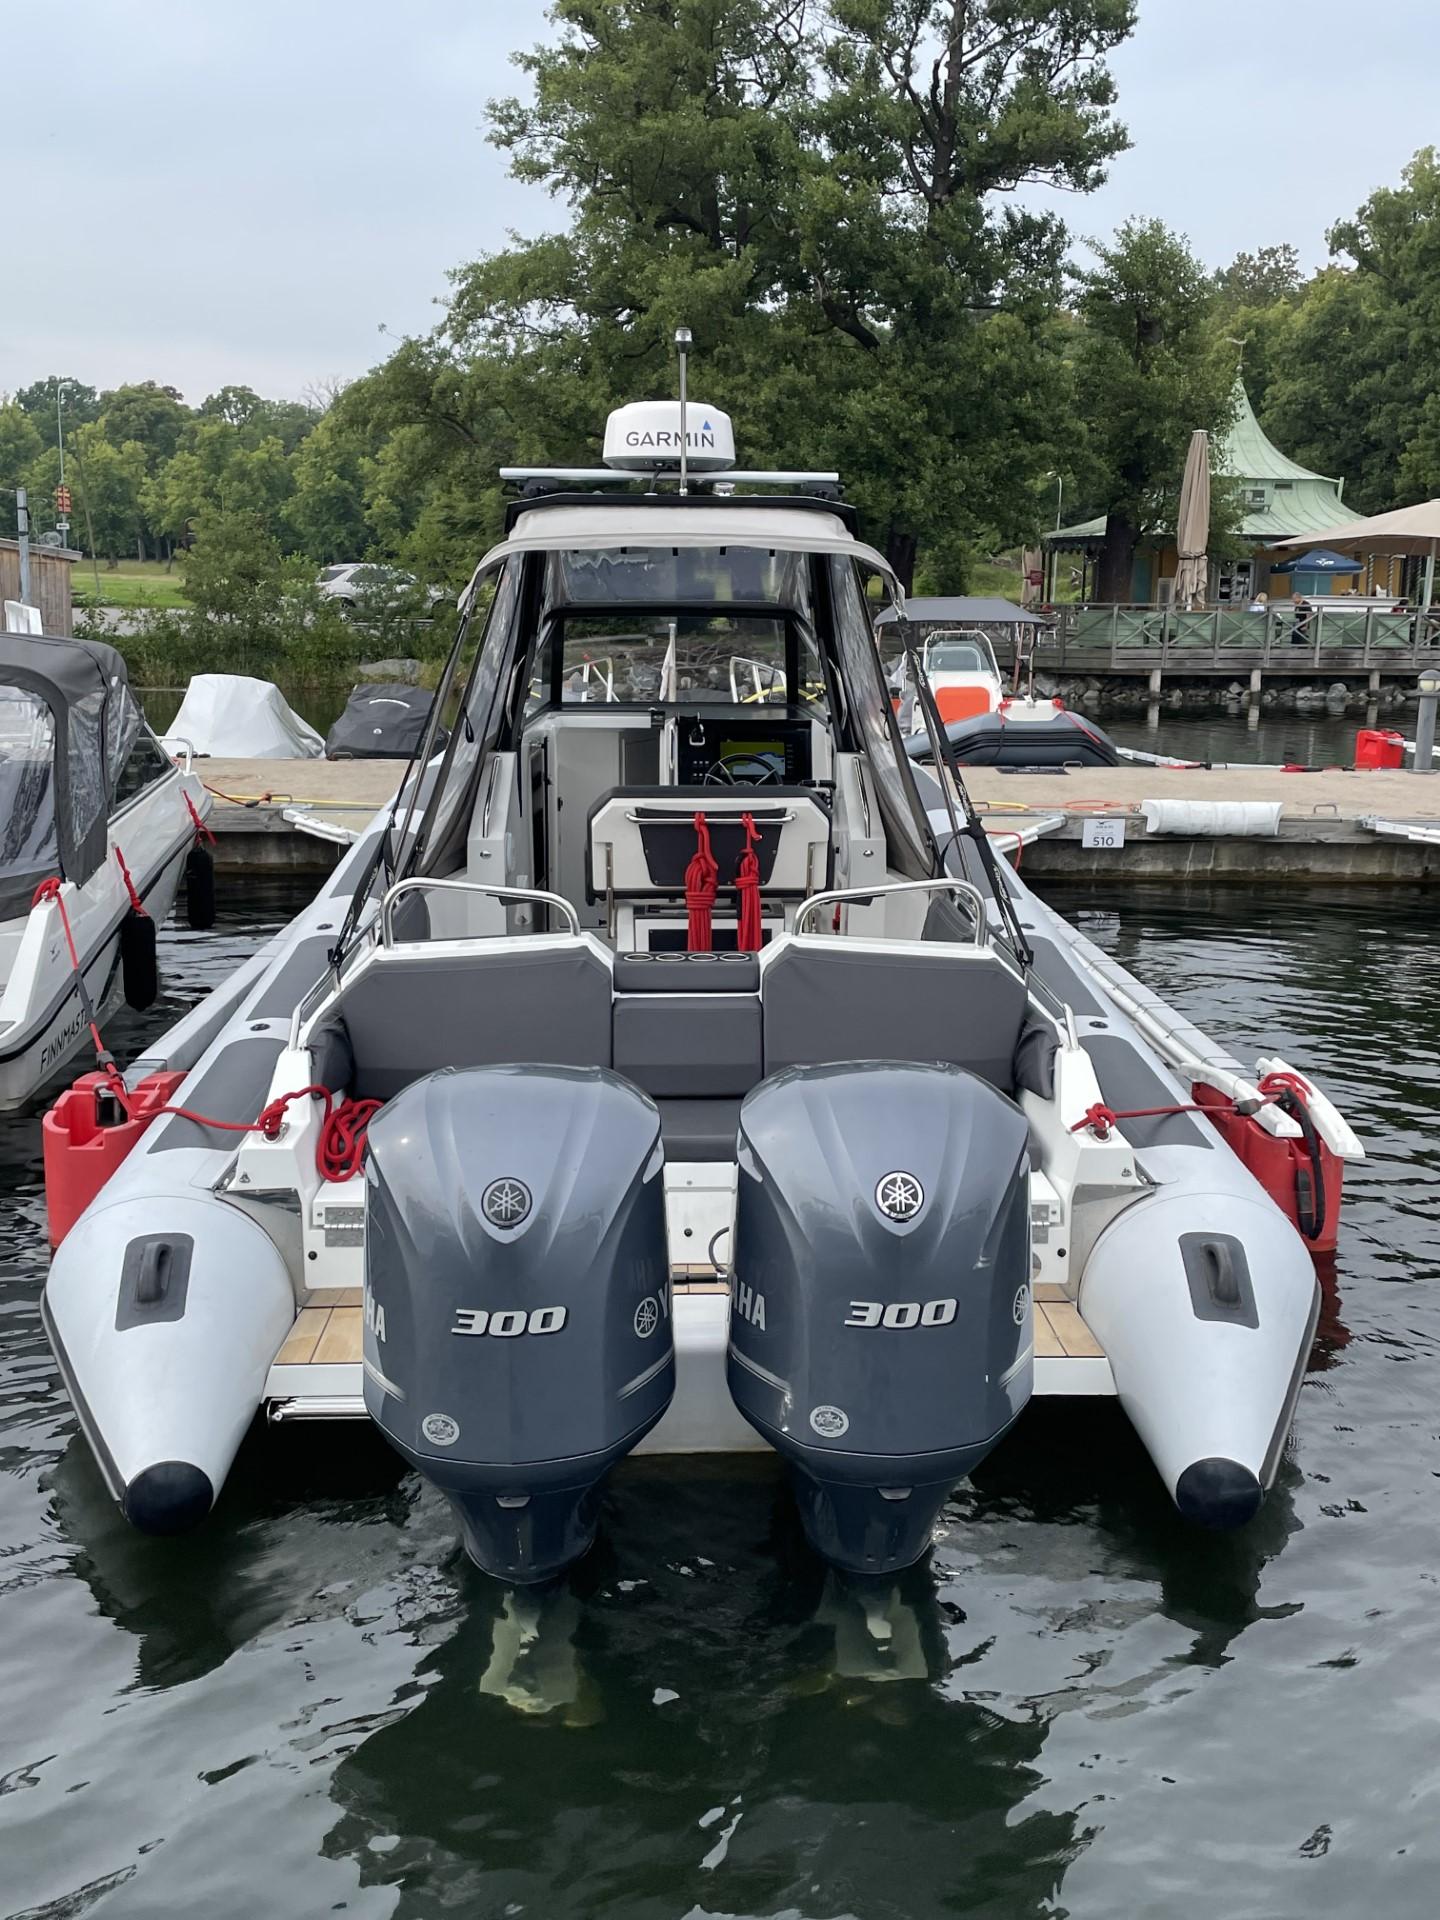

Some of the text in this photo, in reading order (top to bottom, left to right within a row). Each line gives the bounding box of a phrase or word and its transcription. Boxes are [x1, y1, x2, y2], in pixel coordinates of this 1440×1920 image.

[626, 431, 715, 448] GARMIN
[1093, 836, 1114, 846] 510
[40, 998, 94, 1074] FINNMAST
[451, 1305, 567, 1337] 300
[844, 1298, 957, 1329] 300
